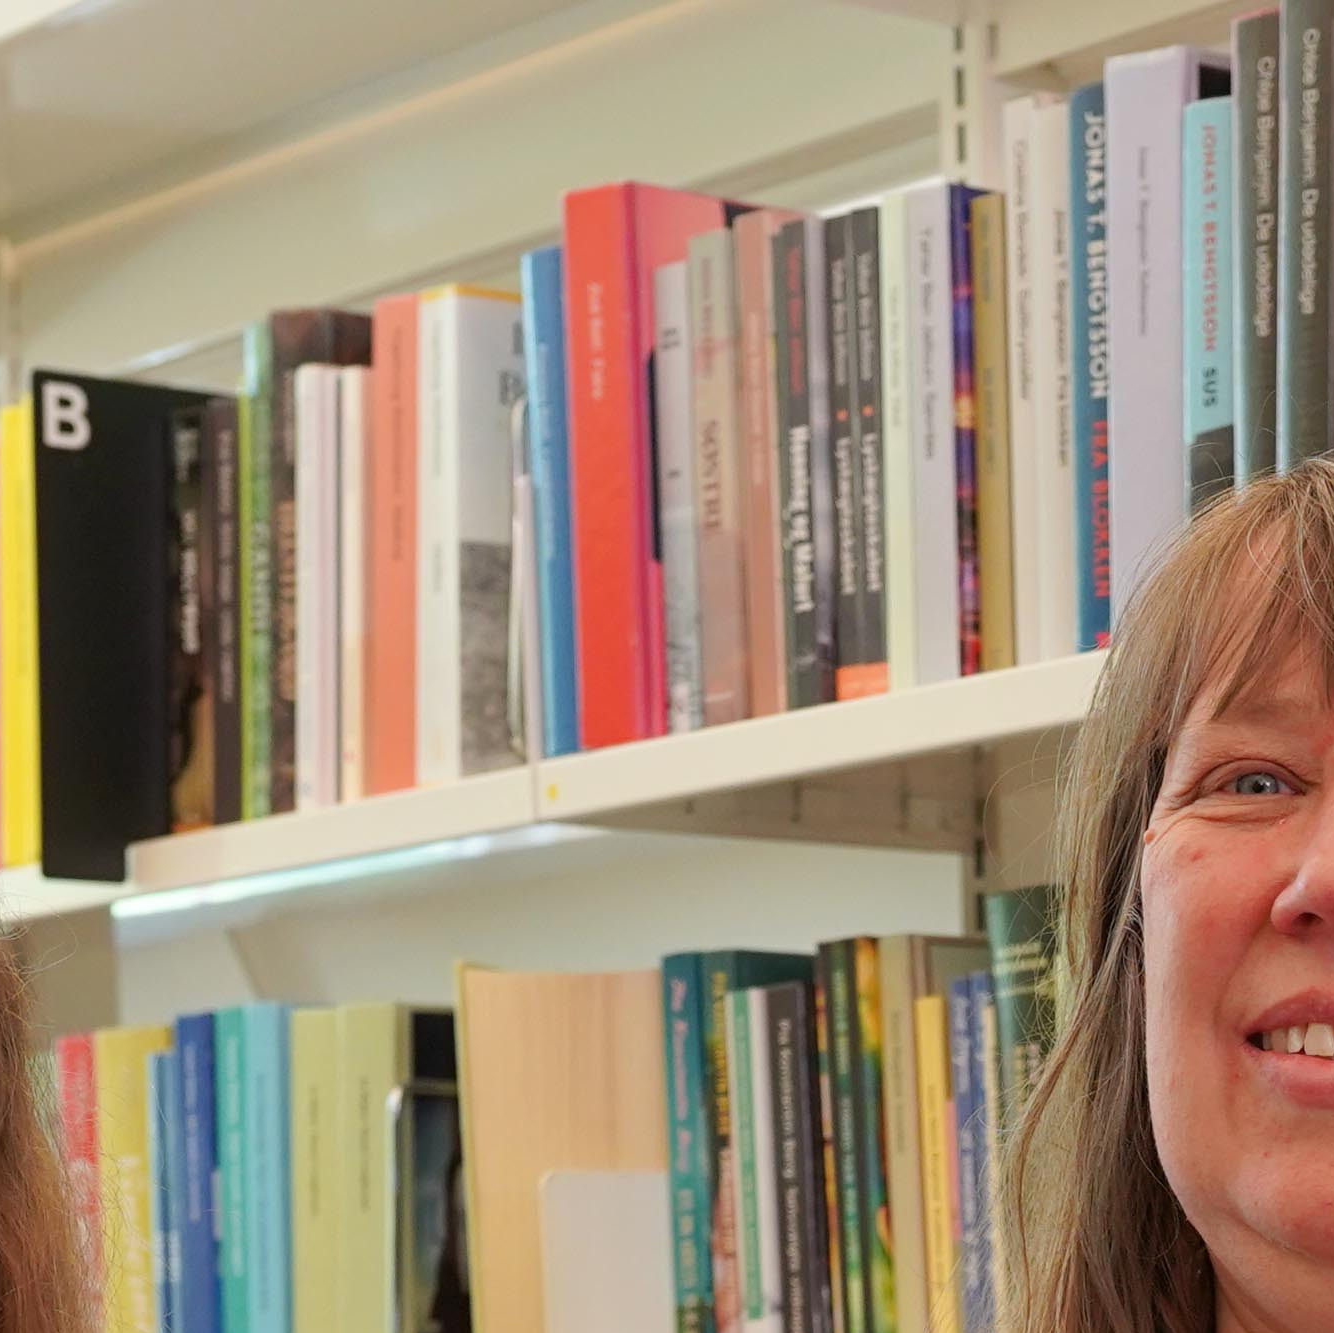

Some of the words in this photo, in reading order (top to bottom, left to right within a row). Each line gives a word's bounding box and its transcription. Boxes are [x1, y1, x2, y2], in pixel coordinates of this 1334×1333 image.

[1084, 111, 1105, 203] JONAS
[1086, 241, 1108, 398] BENGTSSON
[41, 380, 92, 451] B
[1201, 366, 1219, 408] SUS
[1091, 420, 1109, 468] FRA
